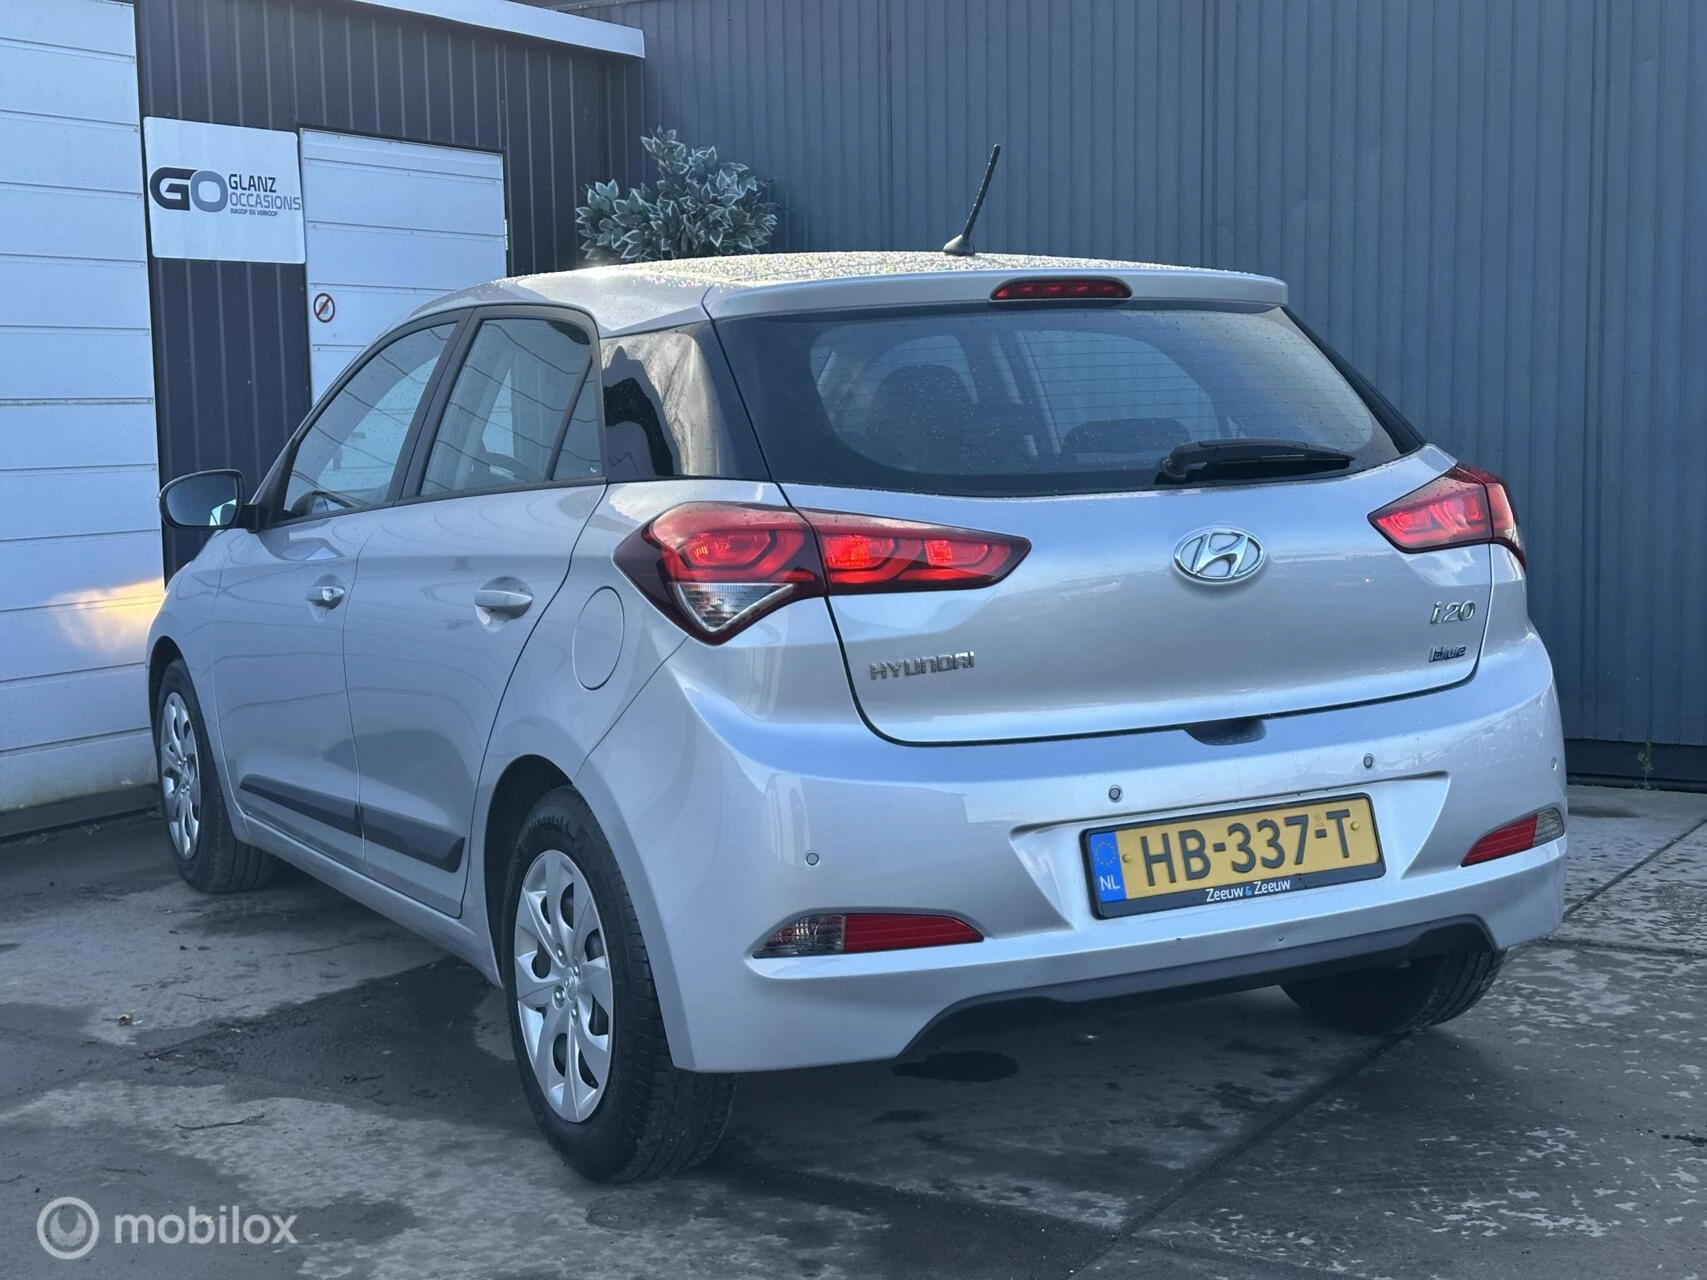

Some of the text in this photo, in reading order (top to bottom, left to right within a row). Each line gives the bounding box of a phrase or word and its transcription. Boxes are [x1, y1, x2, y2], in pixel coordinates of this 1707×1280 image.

[150, 167, 228, 212] GO
[229, 174, 277, 193] GLANZ
[230, 192, 301, 211] OCCASIONS
[1430, 600, 1476, 624] i20
[870, 651, 975, 680] HYUNDAI
[1140, 809, 1352, 887] HB-337-T
[1100, 875, 1121, 892] NL
[1206, 884, 1244, 902] Zeeuw
[1253, 880, 1291, 898] Zeeuw
